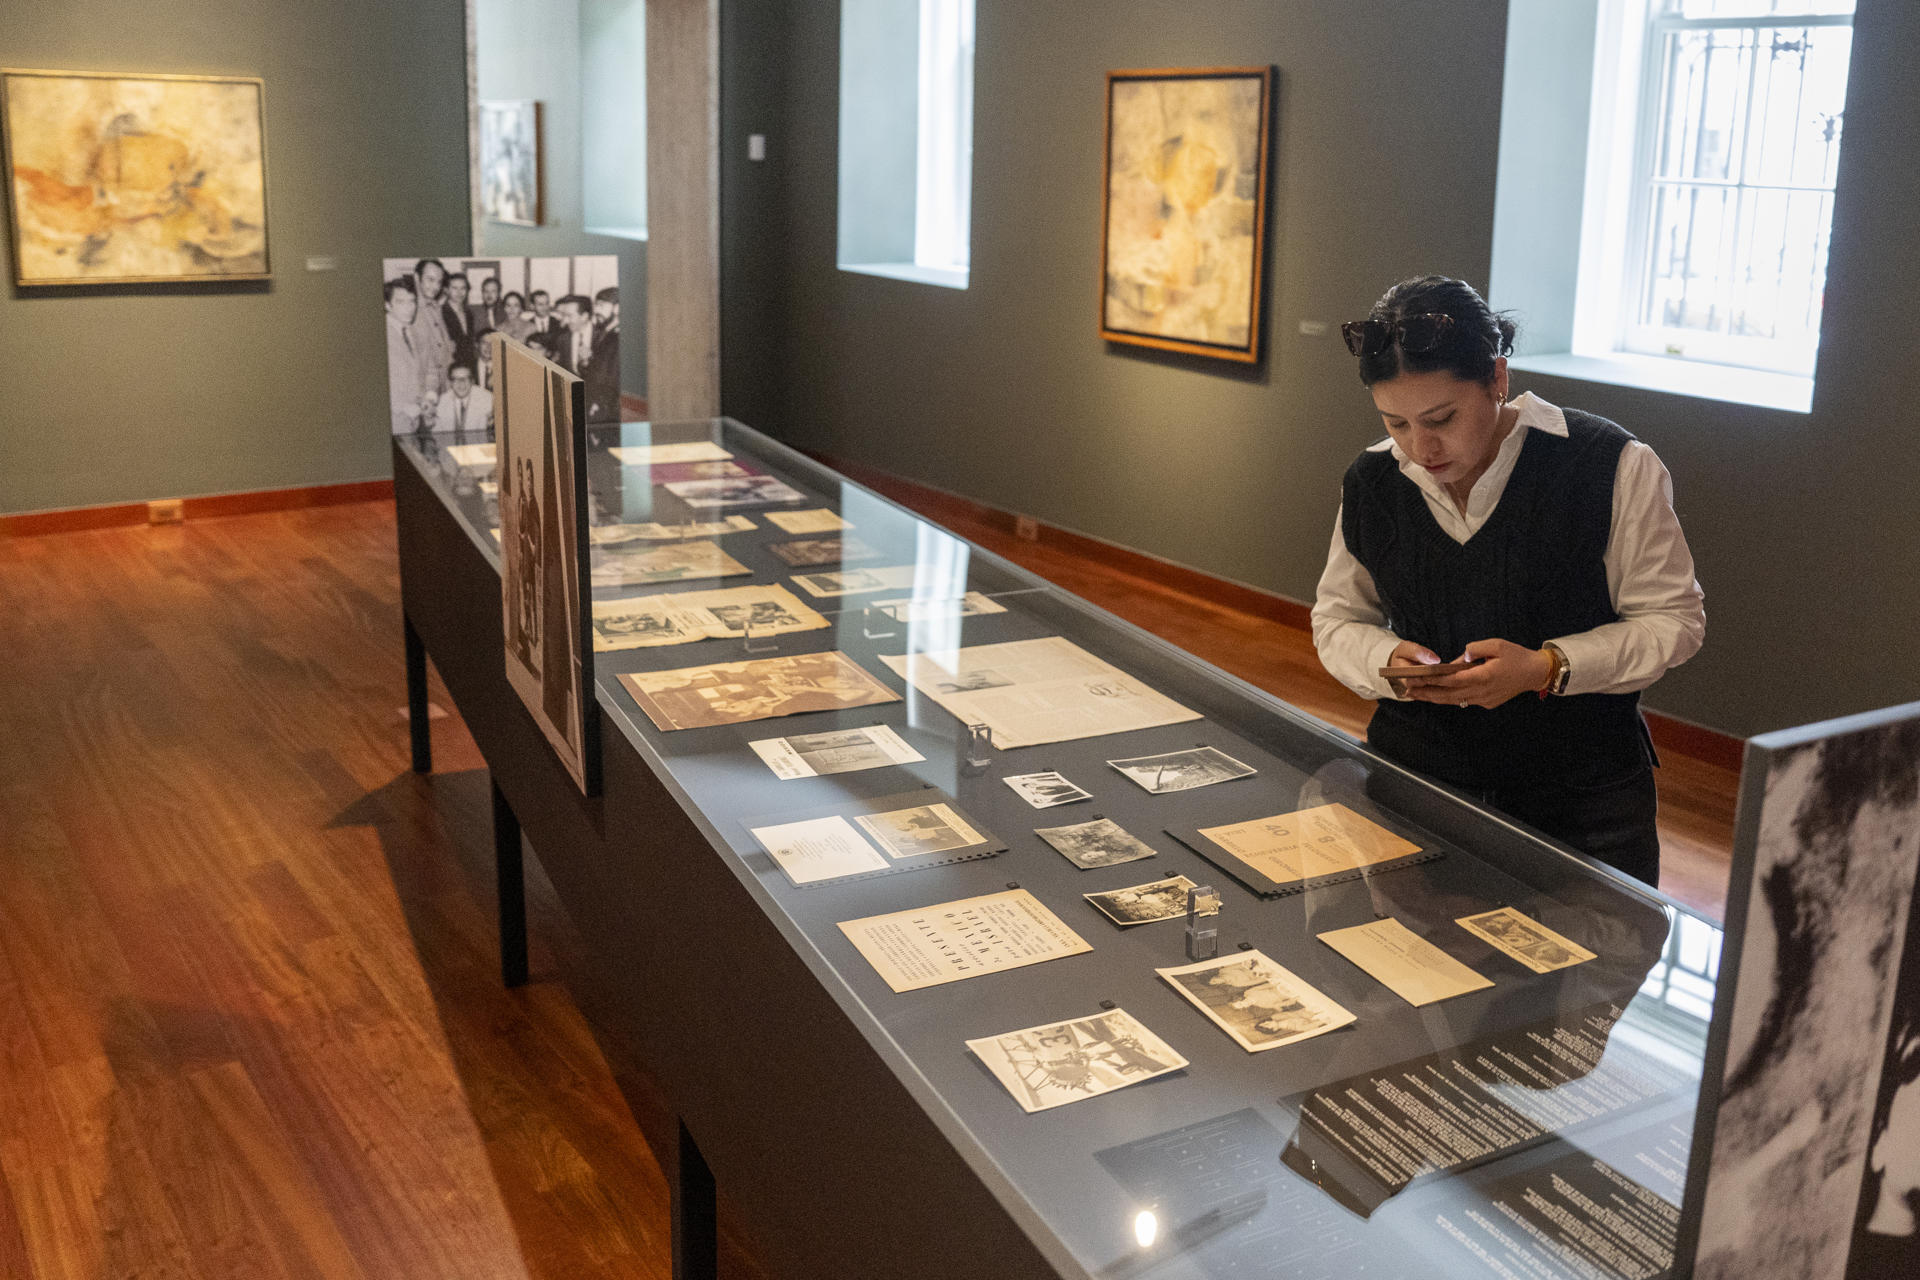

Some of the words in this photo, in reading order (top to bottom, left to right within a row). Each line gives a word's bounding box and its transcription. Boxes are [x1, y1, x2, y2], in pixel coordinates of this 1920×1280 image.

[1264, 823, 1290, 838] 40
[1317, 834, 1333, 845] 8
[961, 909, 1003, 945] ISRAEL
[912, 918, 970, 971] PRESENTE
